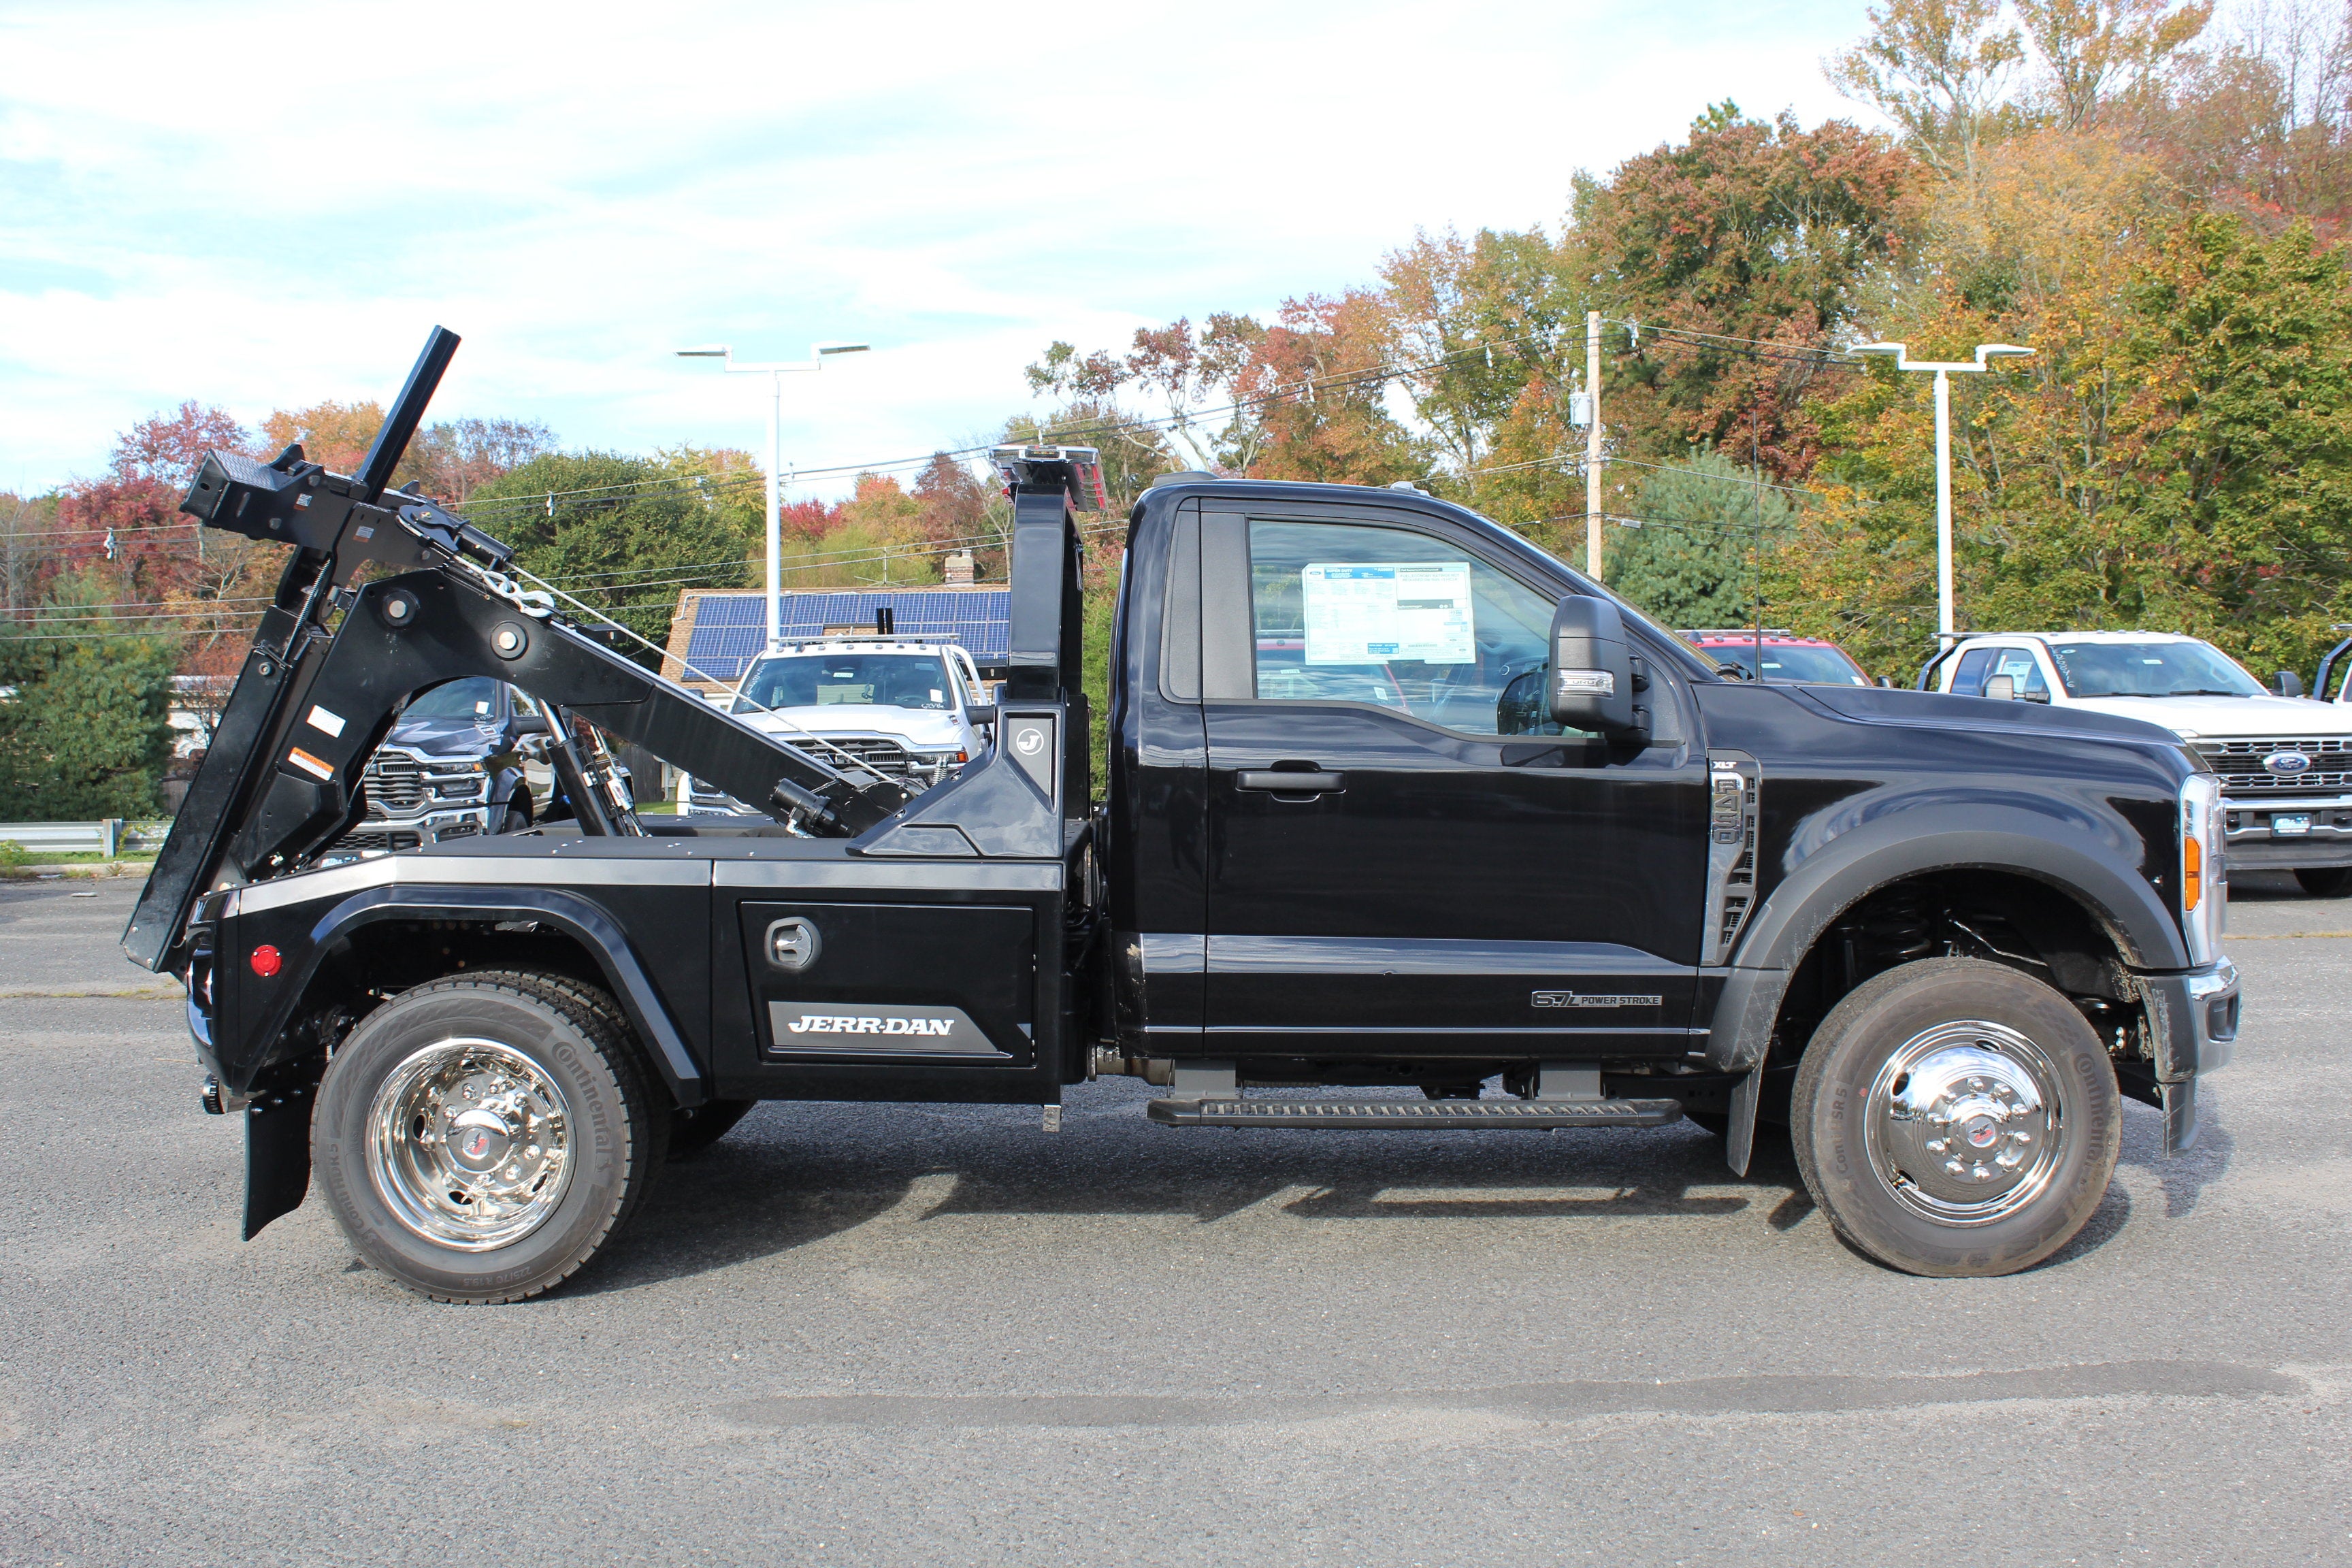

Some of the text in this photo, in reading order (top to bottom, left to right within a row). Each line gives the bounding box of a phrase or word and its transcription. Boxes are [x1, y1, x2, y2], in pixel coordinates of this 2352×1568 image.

[1713, 761, 1737, 769] XLT
[1714, 779, 1737, 845] F450
[1619, 996, 1659, 1004] STROKE
[787, 1015, 955, 1036] JERR-DAN
[552, 1041, 613, 1154] Continental
